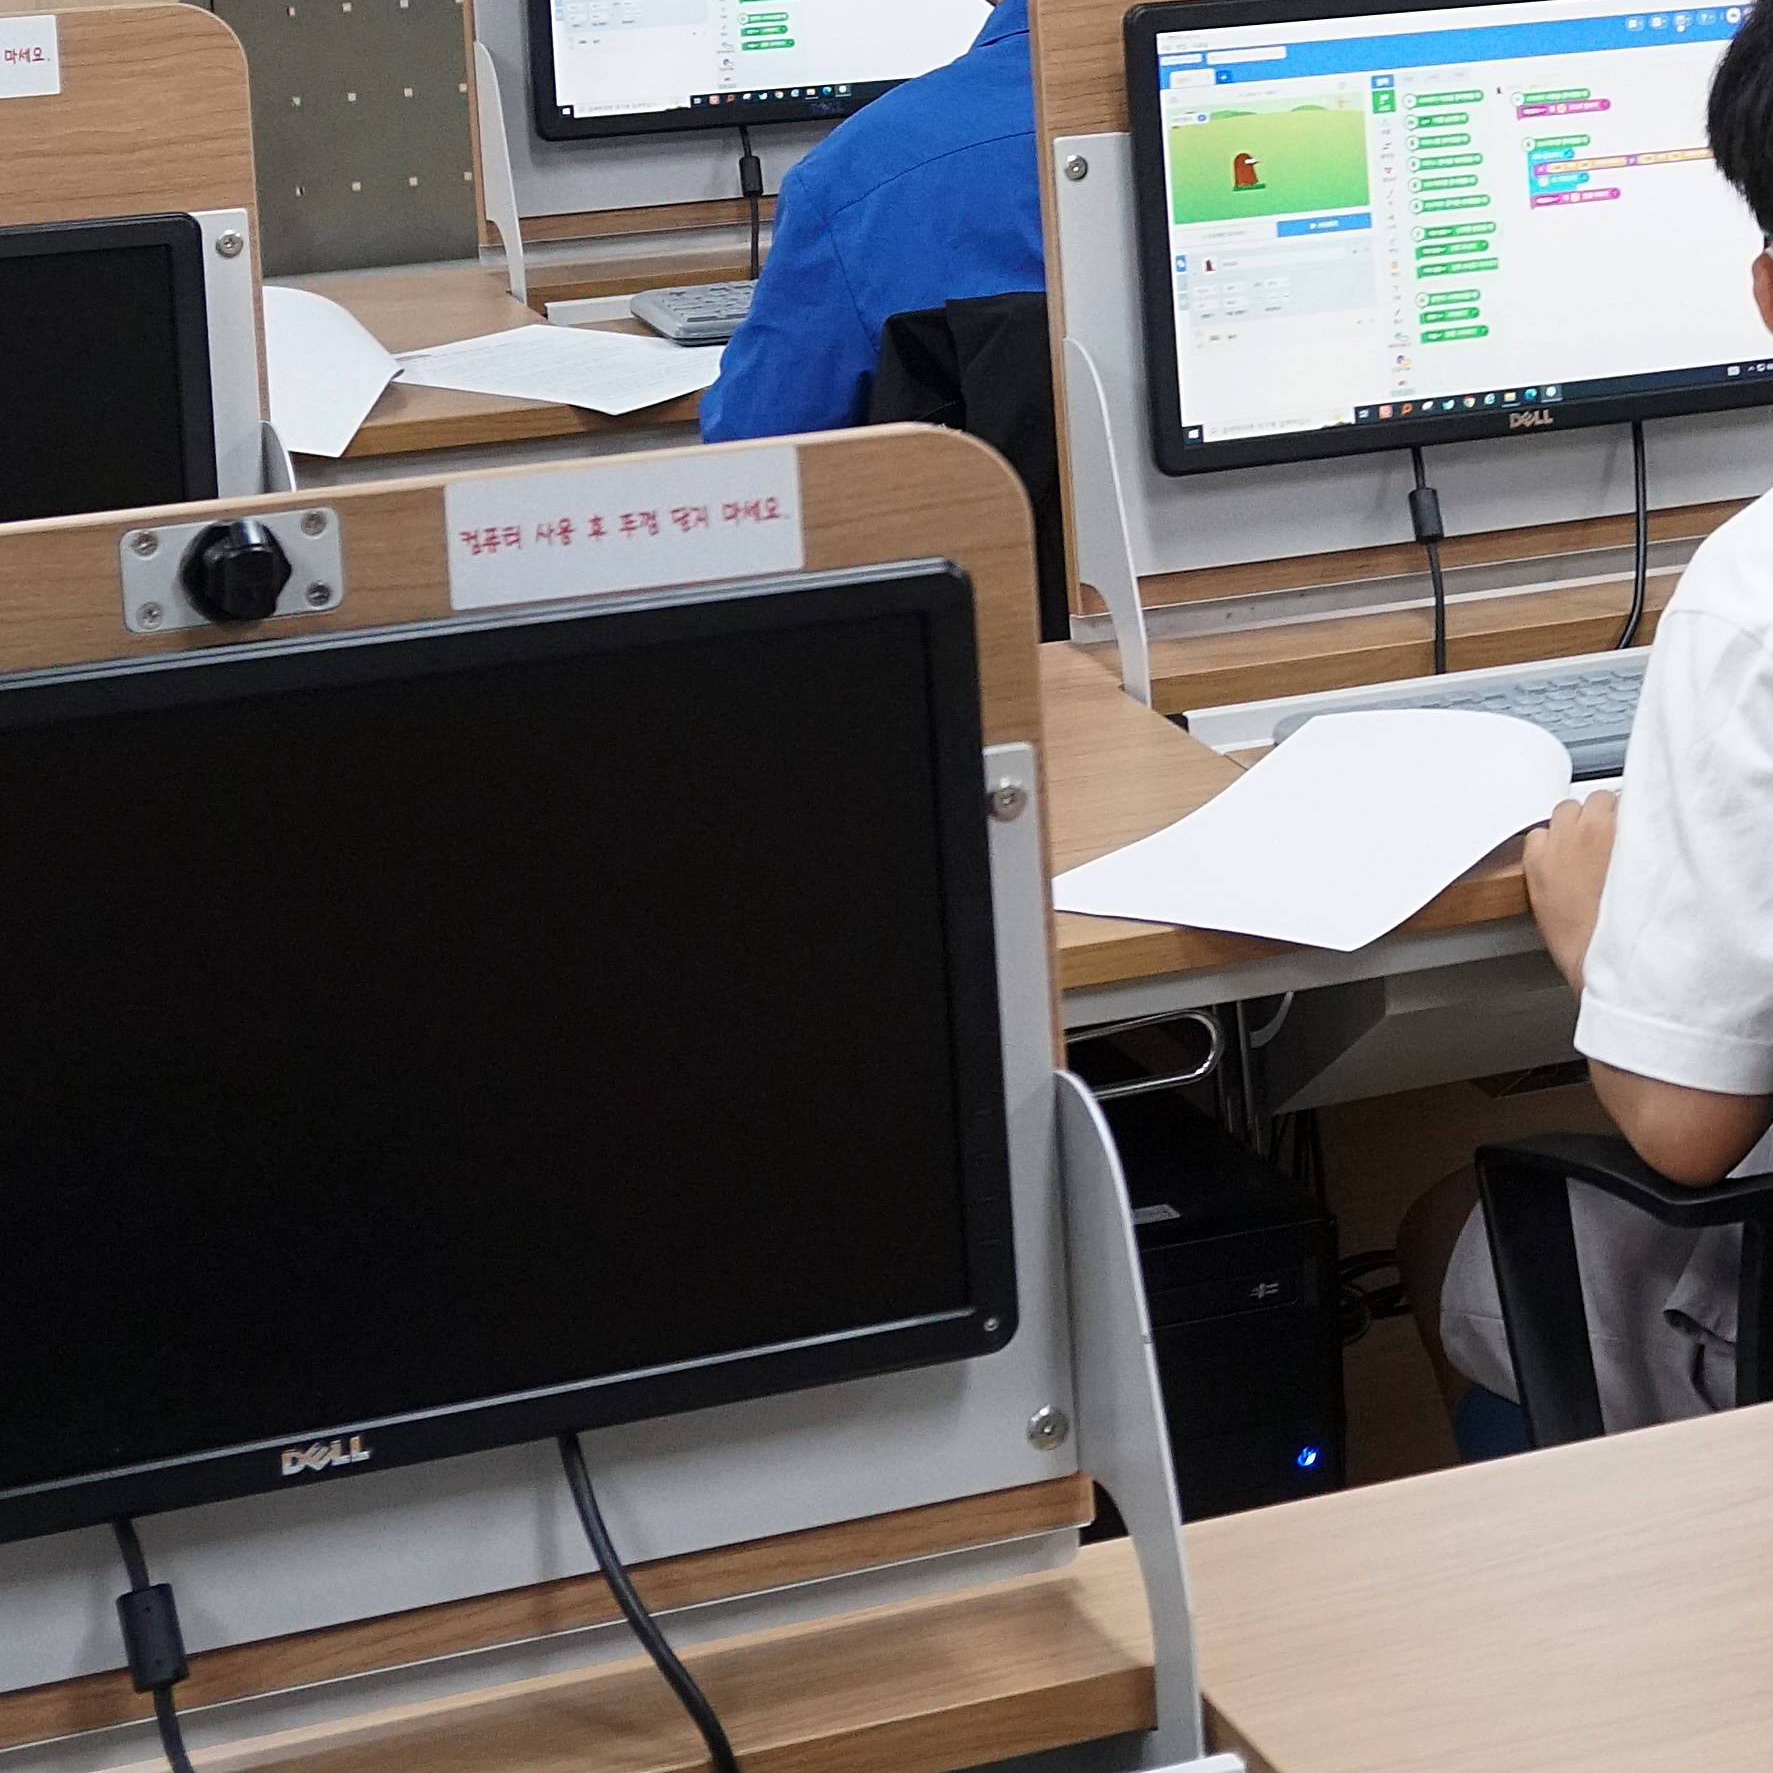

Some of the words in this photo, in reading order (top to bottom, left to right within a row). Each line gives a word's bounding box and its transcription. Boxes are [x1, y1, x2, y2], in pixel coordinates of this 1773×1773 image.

[1508, 409, 1554, 429] DELL
[535, 517, 574, 546] 사용
[588, 513, 606, 540] 후
[281, 1436, 371, 1476] DELL
